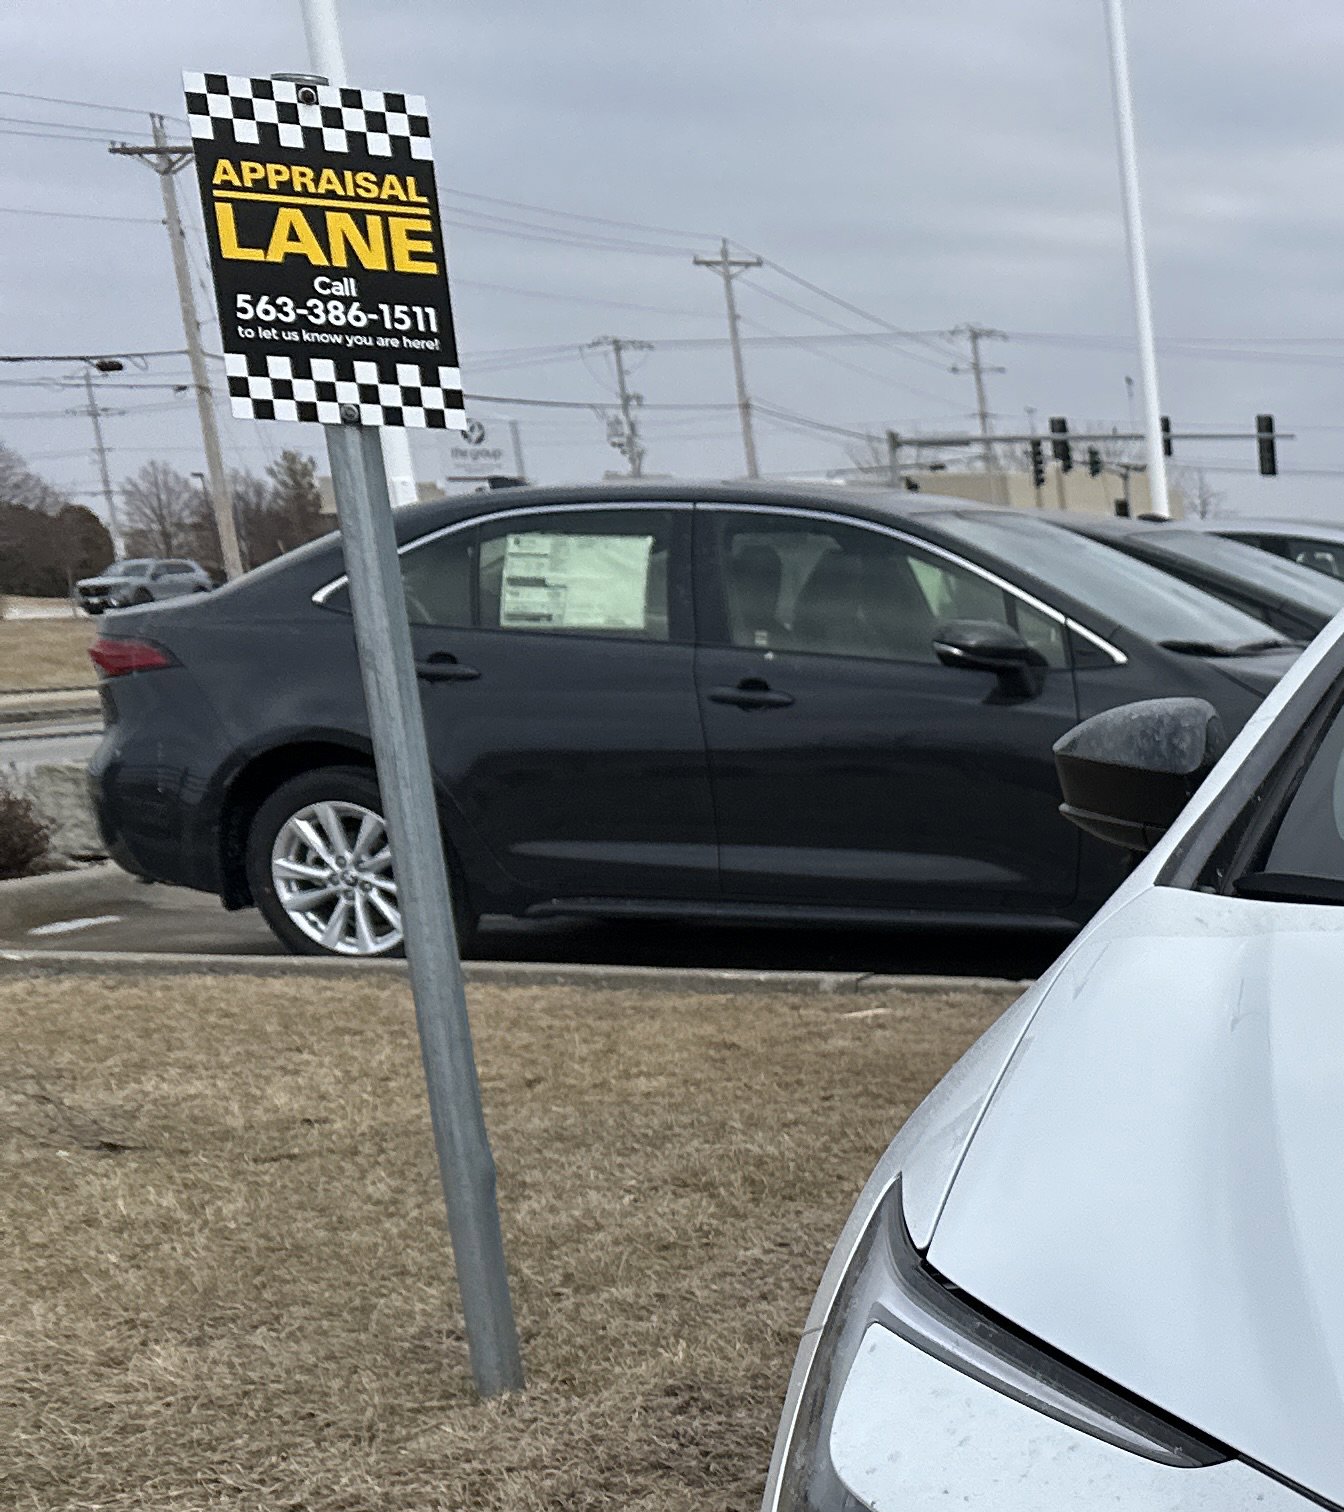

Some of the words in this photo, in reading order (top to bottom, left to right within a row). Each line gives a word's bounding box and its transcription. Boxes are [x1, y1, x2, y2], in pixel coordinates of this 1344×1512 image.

[212, 158, 429, 204] APPRAISAL
[214, 201, 438, 275] LANE
[313, 276, 358, 297] Call
[236, 293, 438, 333] 563-386-1511
[237, 325, 254, 339] to
[258, 326, 279, 341] let
[282, 330, 299, 342] us
[302, 329, 343, 344] know
[345, 335, 373, 348] you
[376, 336, 399, 348] are
[402, 336, 440, 350] here!
